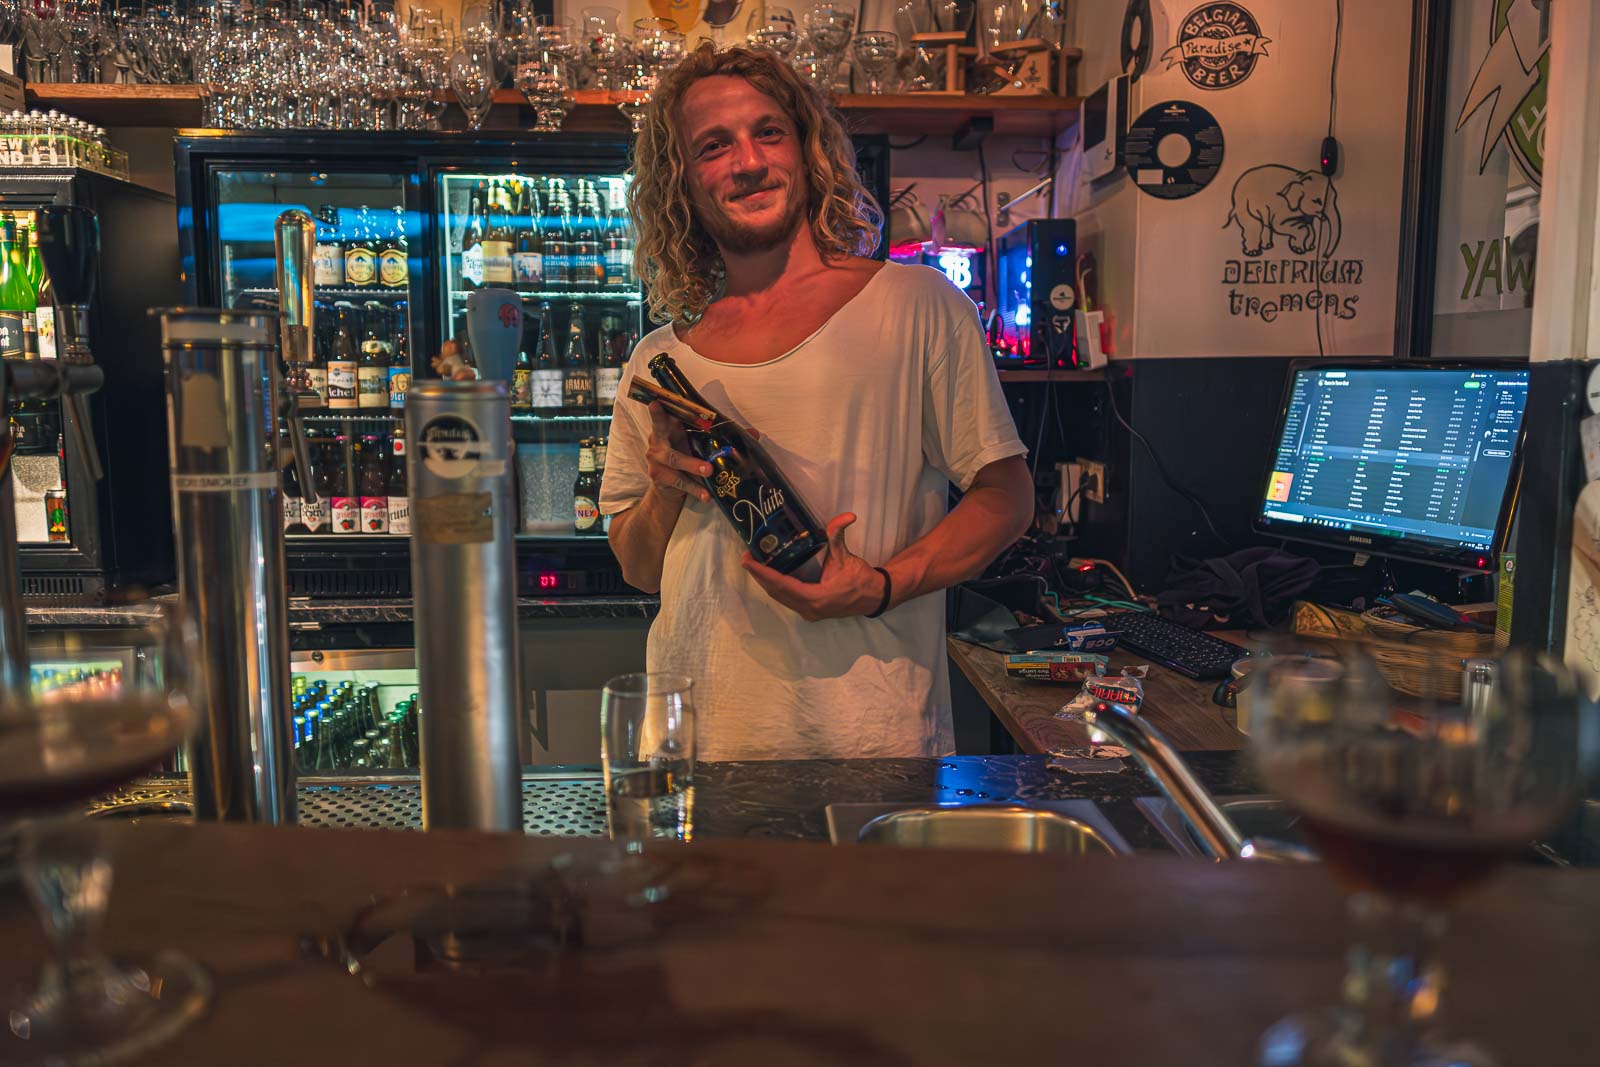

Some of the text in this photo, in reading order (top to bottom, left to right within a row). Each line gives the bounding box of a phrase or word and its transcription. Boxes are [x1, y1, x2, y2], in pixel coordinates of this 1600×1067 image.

[1184, 9, 1248, 36] BELGIAN
[1185, 41, 1242, 55] Paradise
[1192, 64, 1244, 85] BEER
[1222, 259, 1363, 285] DELIRIUM
[1228, 289, 1360, 323] tremens
[733, 484, 784, 545] Nuits
[1085, 637, 1115, 649] OCB
